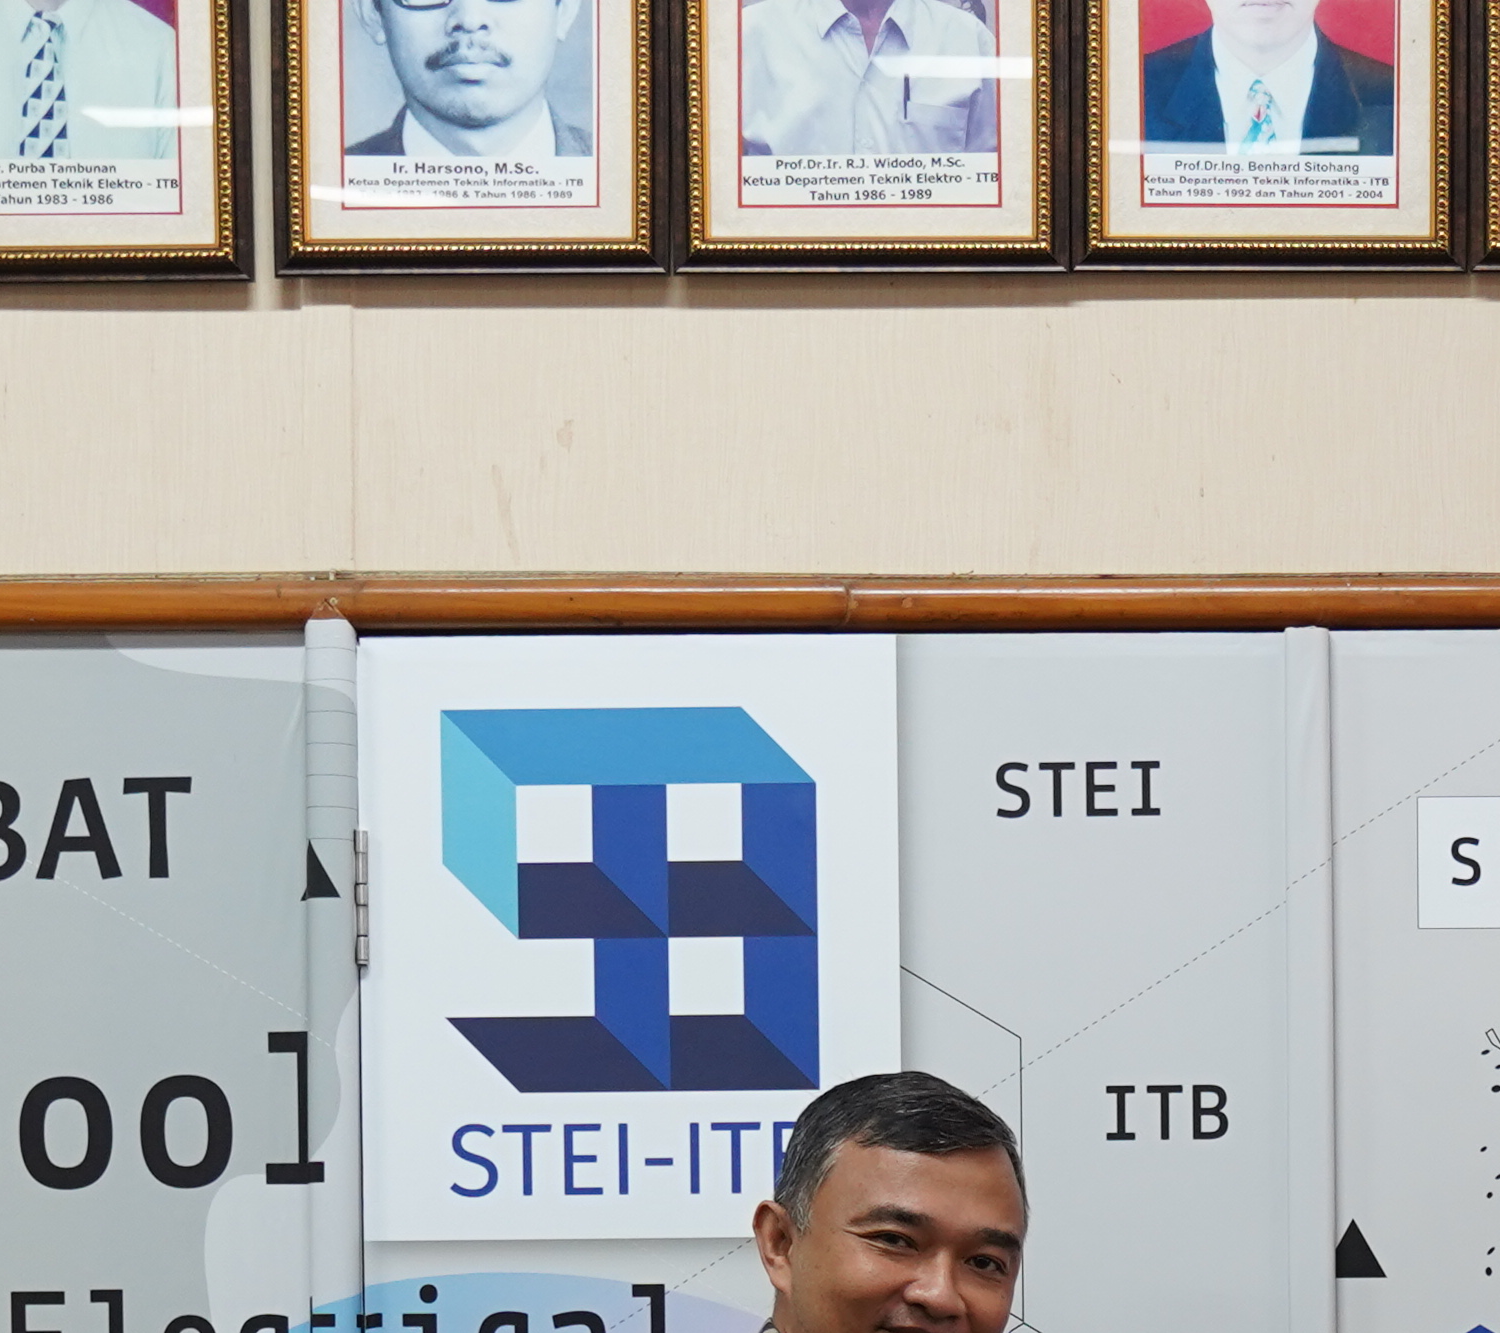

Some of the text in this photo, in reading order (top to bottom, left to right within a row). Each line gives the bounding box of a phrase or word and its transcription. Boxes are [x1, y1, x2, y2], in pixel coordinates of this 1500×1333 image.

[392, 162, 539, 177] Ir. Harsono, M.Sc.
[775, 156, 965, 170] Prof.Dr.Ir. R.J. Widodo, M.Sc.
[994, 759, 1162, 820] STEI
[1104, 1083, 1230, 1143] ITB
